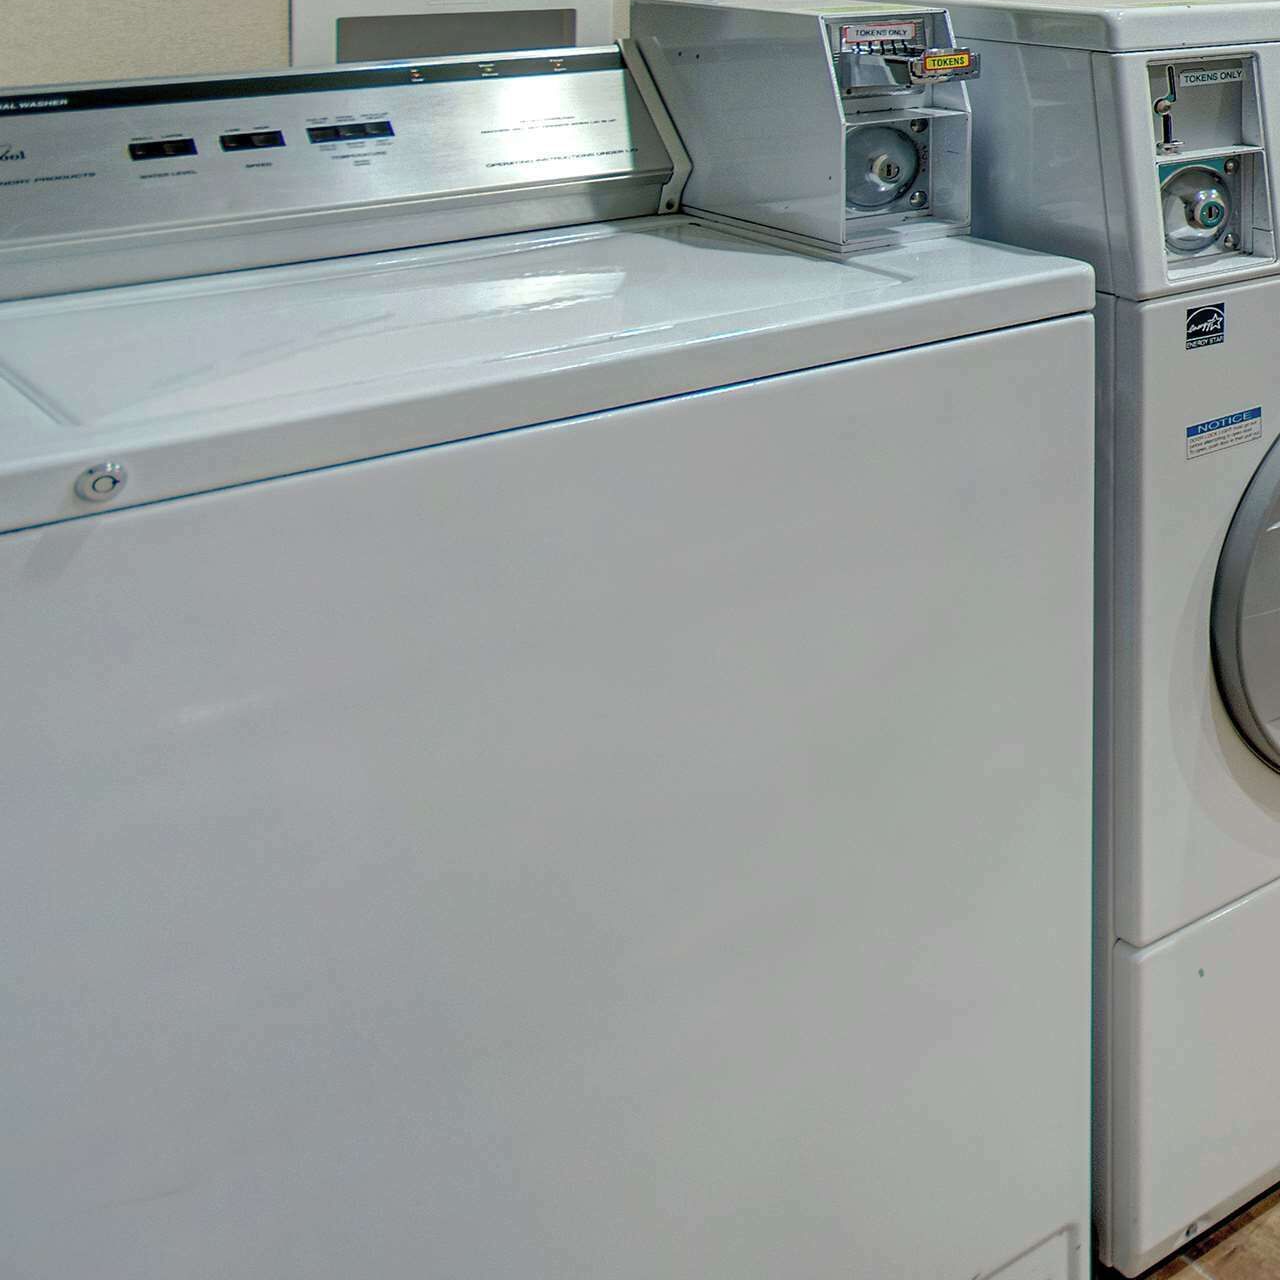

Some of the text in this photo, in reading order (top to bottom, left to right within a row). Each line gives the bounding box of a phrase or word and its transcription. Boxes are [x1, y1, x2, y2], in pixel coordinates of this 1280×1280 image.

[855, 28, 908, 37] TOKENS ONLY
[931, 56, 966, 67] TOKENS
[1184, 70, 1243, 83] TOKENS ONLY
[19, 98, 69, 109] WASHER
[1187, 334, 1225, 350] ENERGY STAR
[1197, 412, 1251, 434] NOTICE
